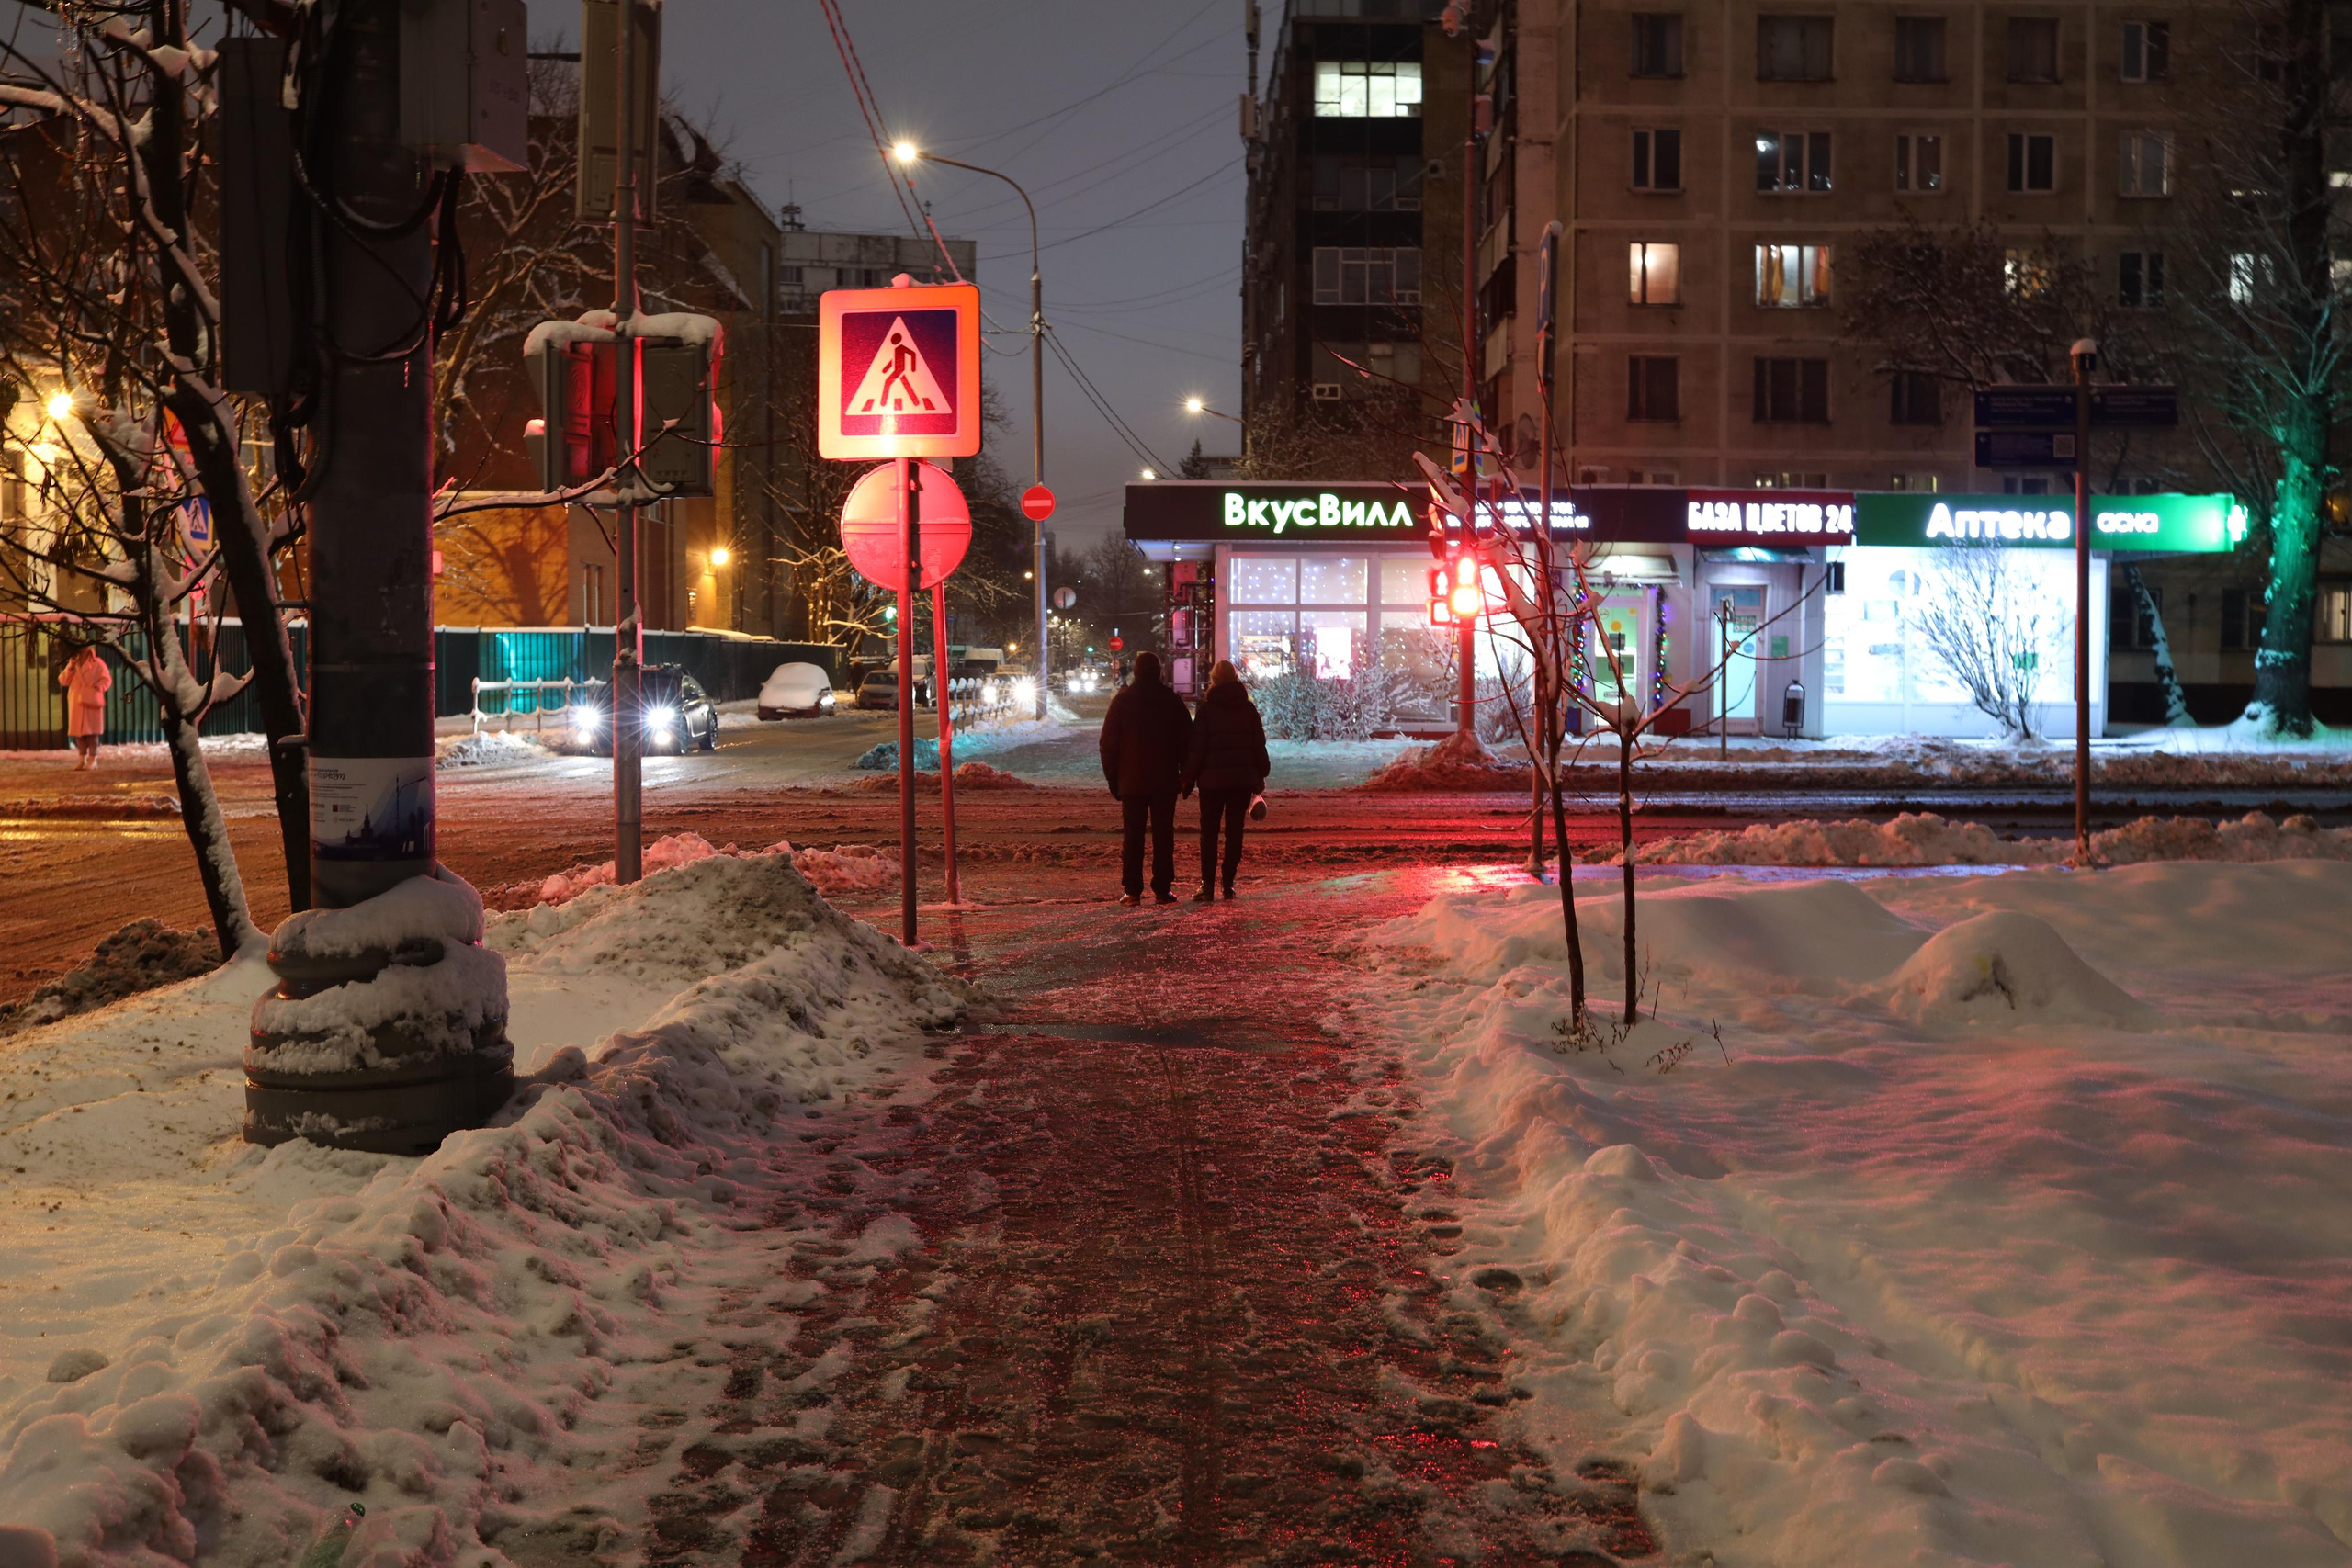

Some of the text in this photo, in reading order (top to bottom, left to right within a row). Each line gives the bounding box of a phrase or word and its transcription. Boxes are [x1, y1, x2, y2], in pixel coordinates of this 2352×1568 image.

[1224, 492, 1414, 534] ВкусВилл
[1688, 502, 1854, 534] БАЗА ЦВЕТОВ 24
[1926, 502, 2071, 539] Аптека
